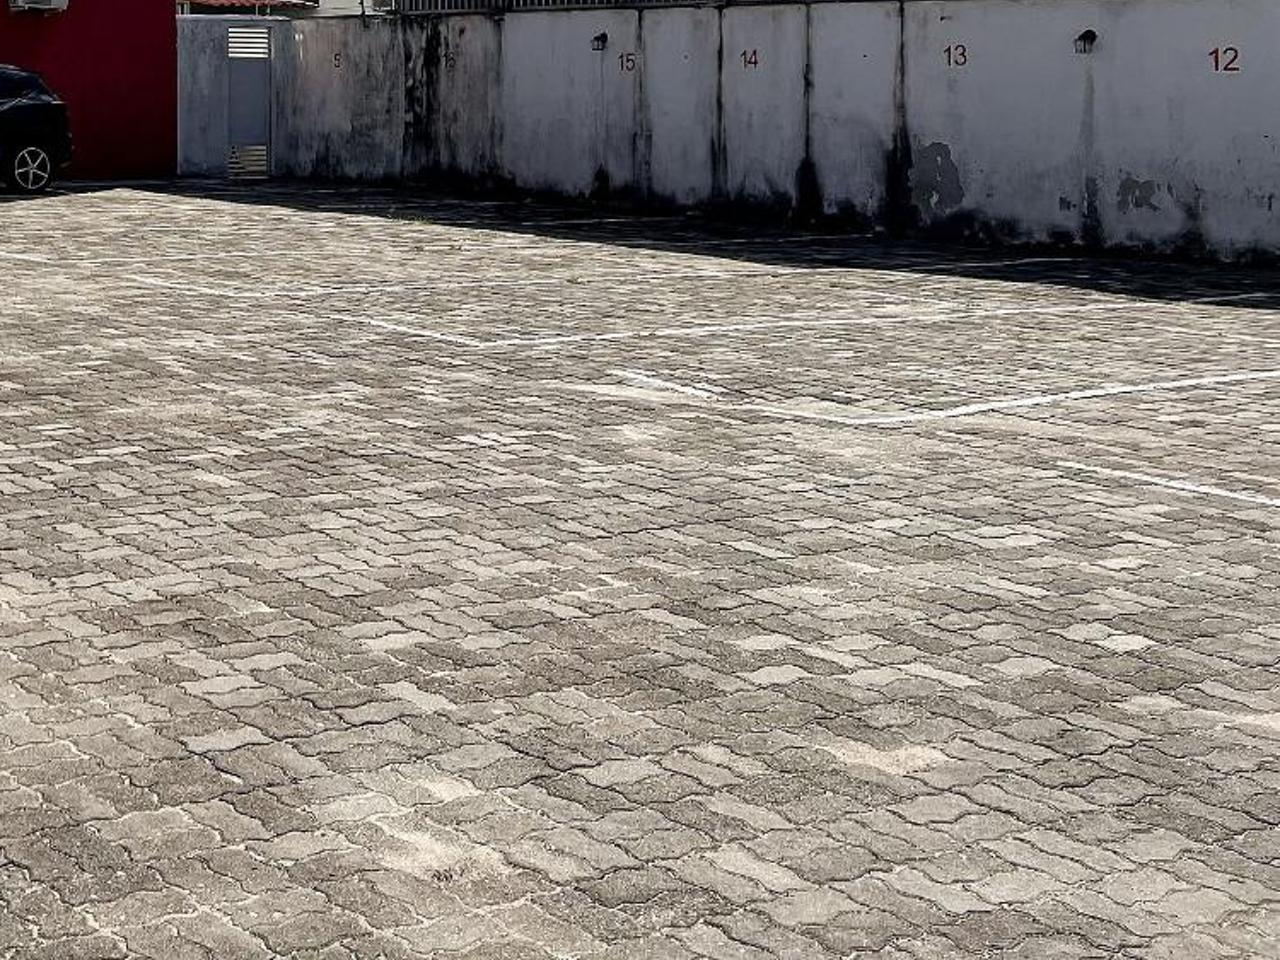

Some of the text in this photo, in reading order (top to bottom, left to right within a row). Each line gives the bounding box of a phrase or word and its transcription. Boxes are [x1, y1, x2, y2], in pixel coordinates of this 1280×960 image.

[619, 52, 636, 72] 15
[740, 49, 759, 69] 14
[943, 44, 968, 67] 13
[1207, 46, 1241, 72] 12
